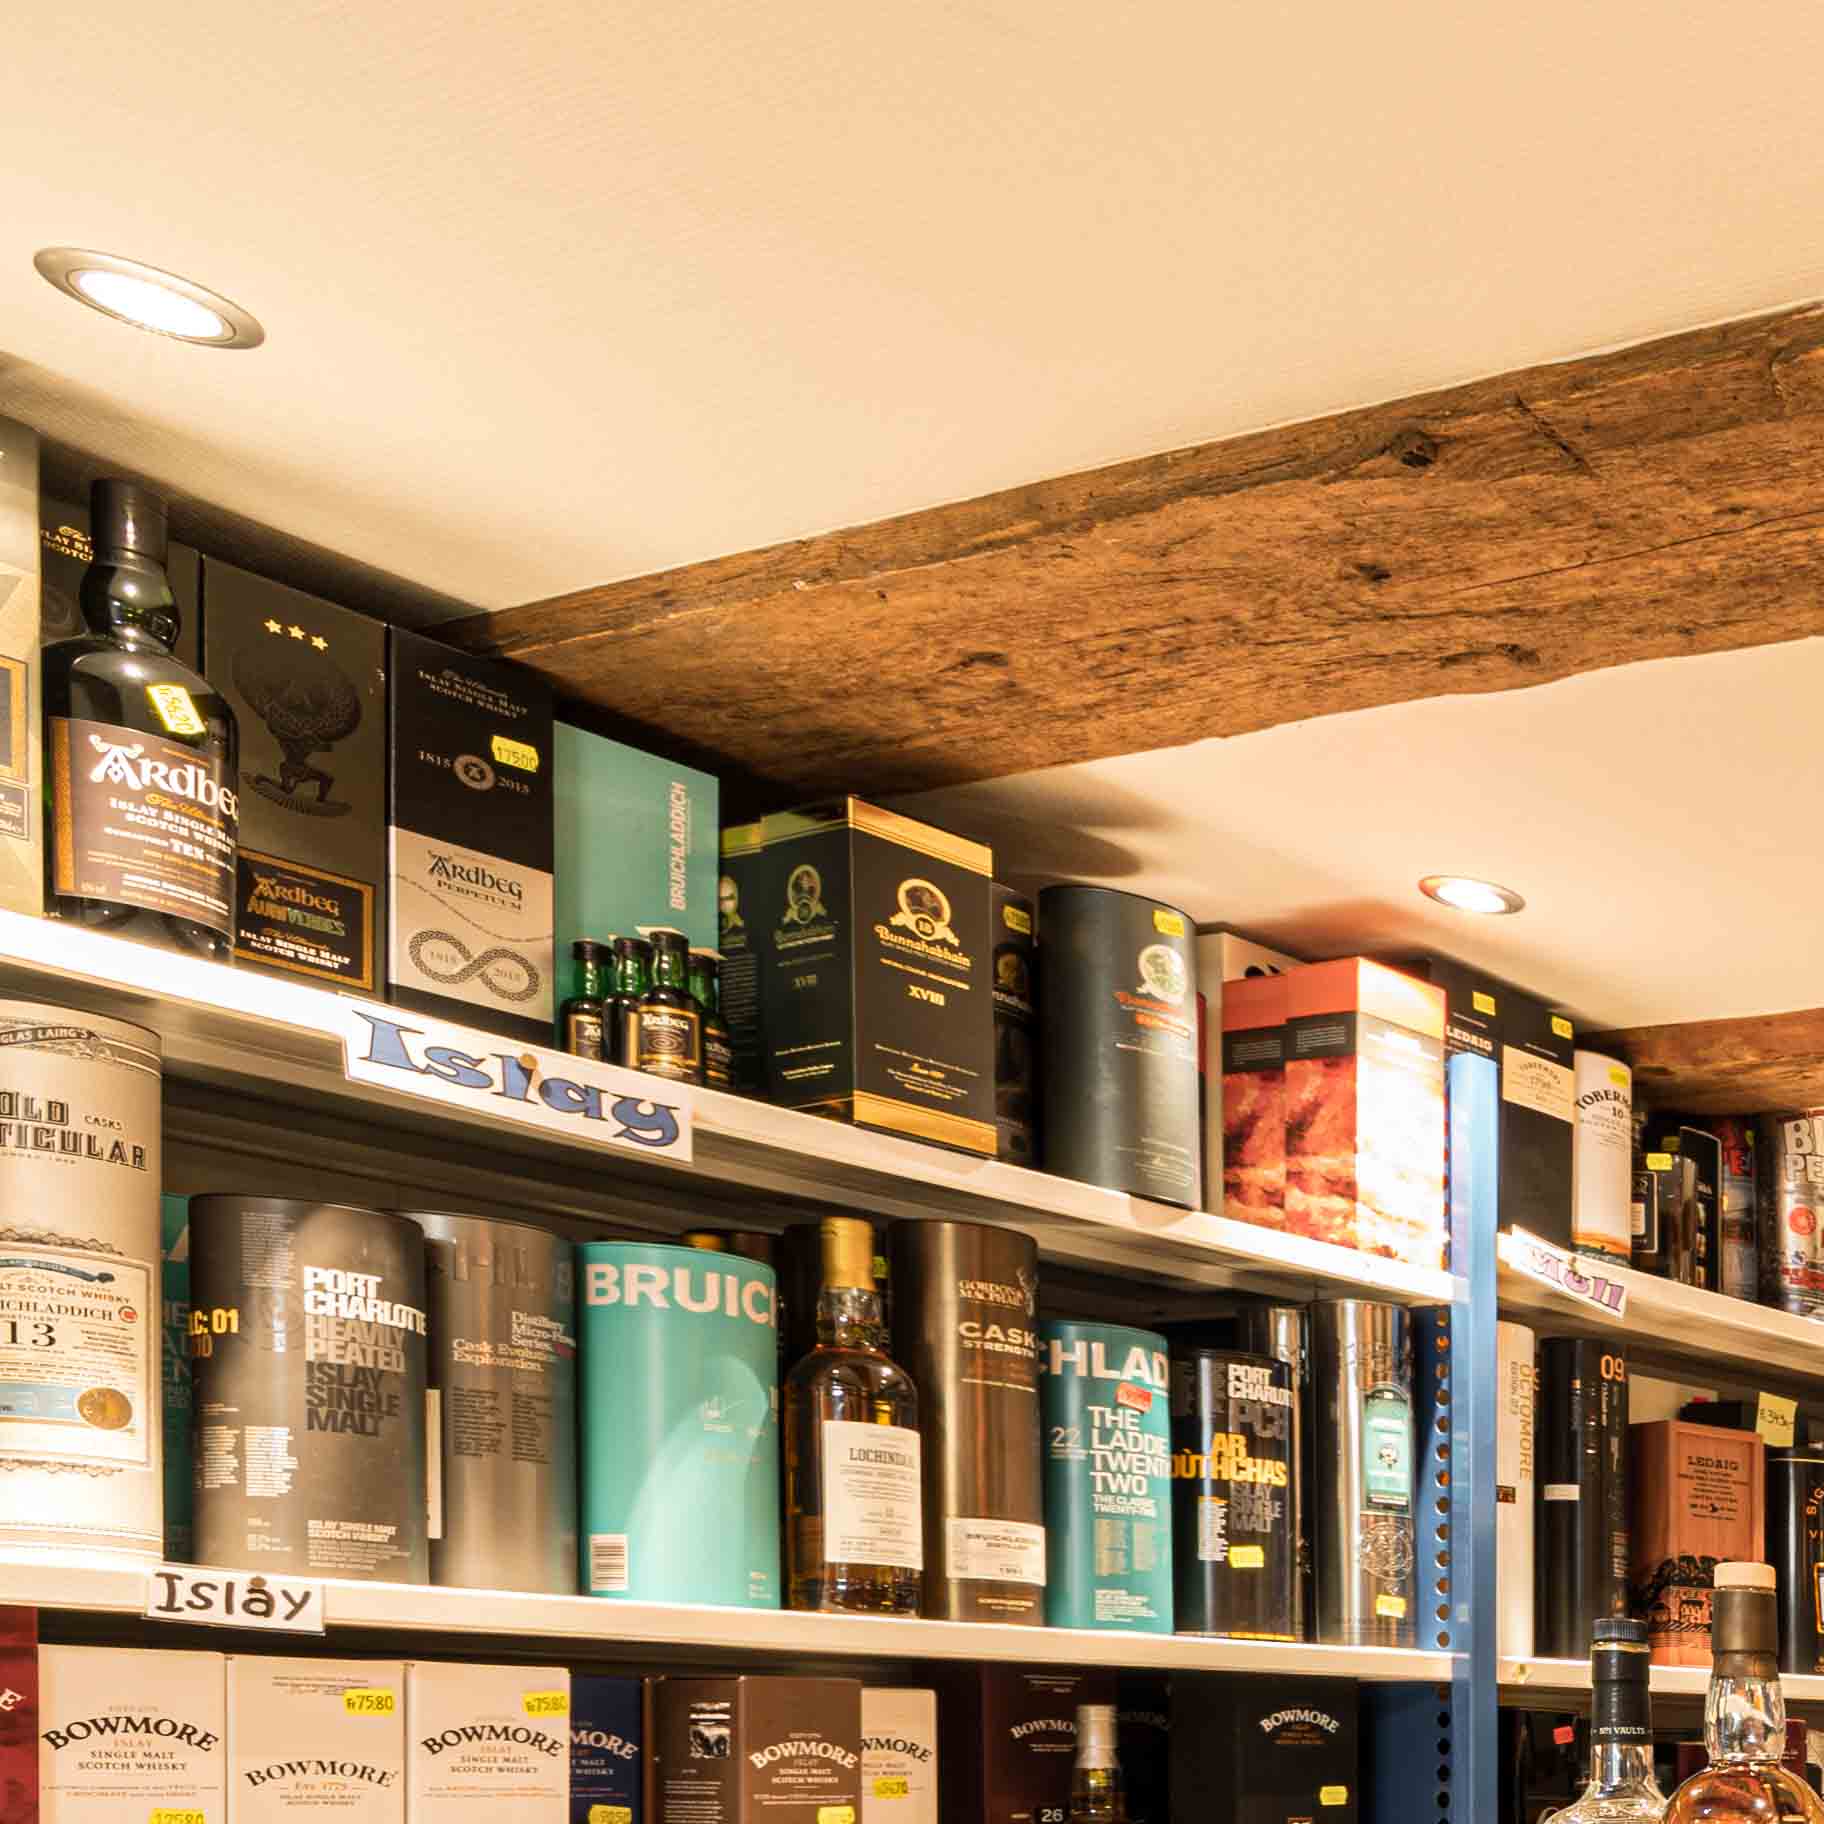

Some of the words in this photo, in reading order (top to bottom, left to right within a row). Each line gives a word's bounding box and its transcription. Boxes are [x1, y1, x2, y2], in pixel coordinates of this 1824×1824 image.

[124, 812, 190, 836] SCOTCH
[668, 781, 689, 912] BRUICHLADDICH
[428, 848, 524, 903] Ardbeg
[908, 984, 946, 1008] XVIII
[350, 1008, 682, 1149] Islay
[17, 1281, 77, 1298] SCOTCH
[80, 1289, 133, 1306] WHISKY
[303, 1265, 383, 1299] PORT
[5, 1318, 58, 1349] 13
[959, 1320, 1038, 1348] CASK
[304, 1336, 407, 1374] PEATED
[305, 1360, 386, 1392] ISLAY
[1228, 1363, 1272, 1390] PORT
[305, 1384, 400, 1419] SINGLE
[305, 1408, 385, 1438] MALT
[1088, 1405, 1140, 1433] THE
[1687, 1456, 1739, 1472] LEDAIG
[1091, 1472, 1148, 1497] TWO
[154, 1570, 312, 1624] Islay
[41, 1715, 220, 1752] BOWMORE
[1258, 1708, 1340, 1734] BOWMORE
[90, 1750, 137, 1760] SINGLE
[143, 1750, 176, 1760] MALT
[421, 1725, 564, 1758] BOWMORE
[748, 1741, 859, 1770] BOWMORE
[78, 1761, 131, 1771] SCOTCH
[136, 1761, 188, 1771] WHISKY
[450, 1765, 494, 1774] SCOTCH
[496, 1765, 539, 1774] WHISKY
[460, 1755, 499, 1764] SINGLE
[503, 1756, 529, 1764] MALT
[243, 1760, 399, 1789] BOWMORE
